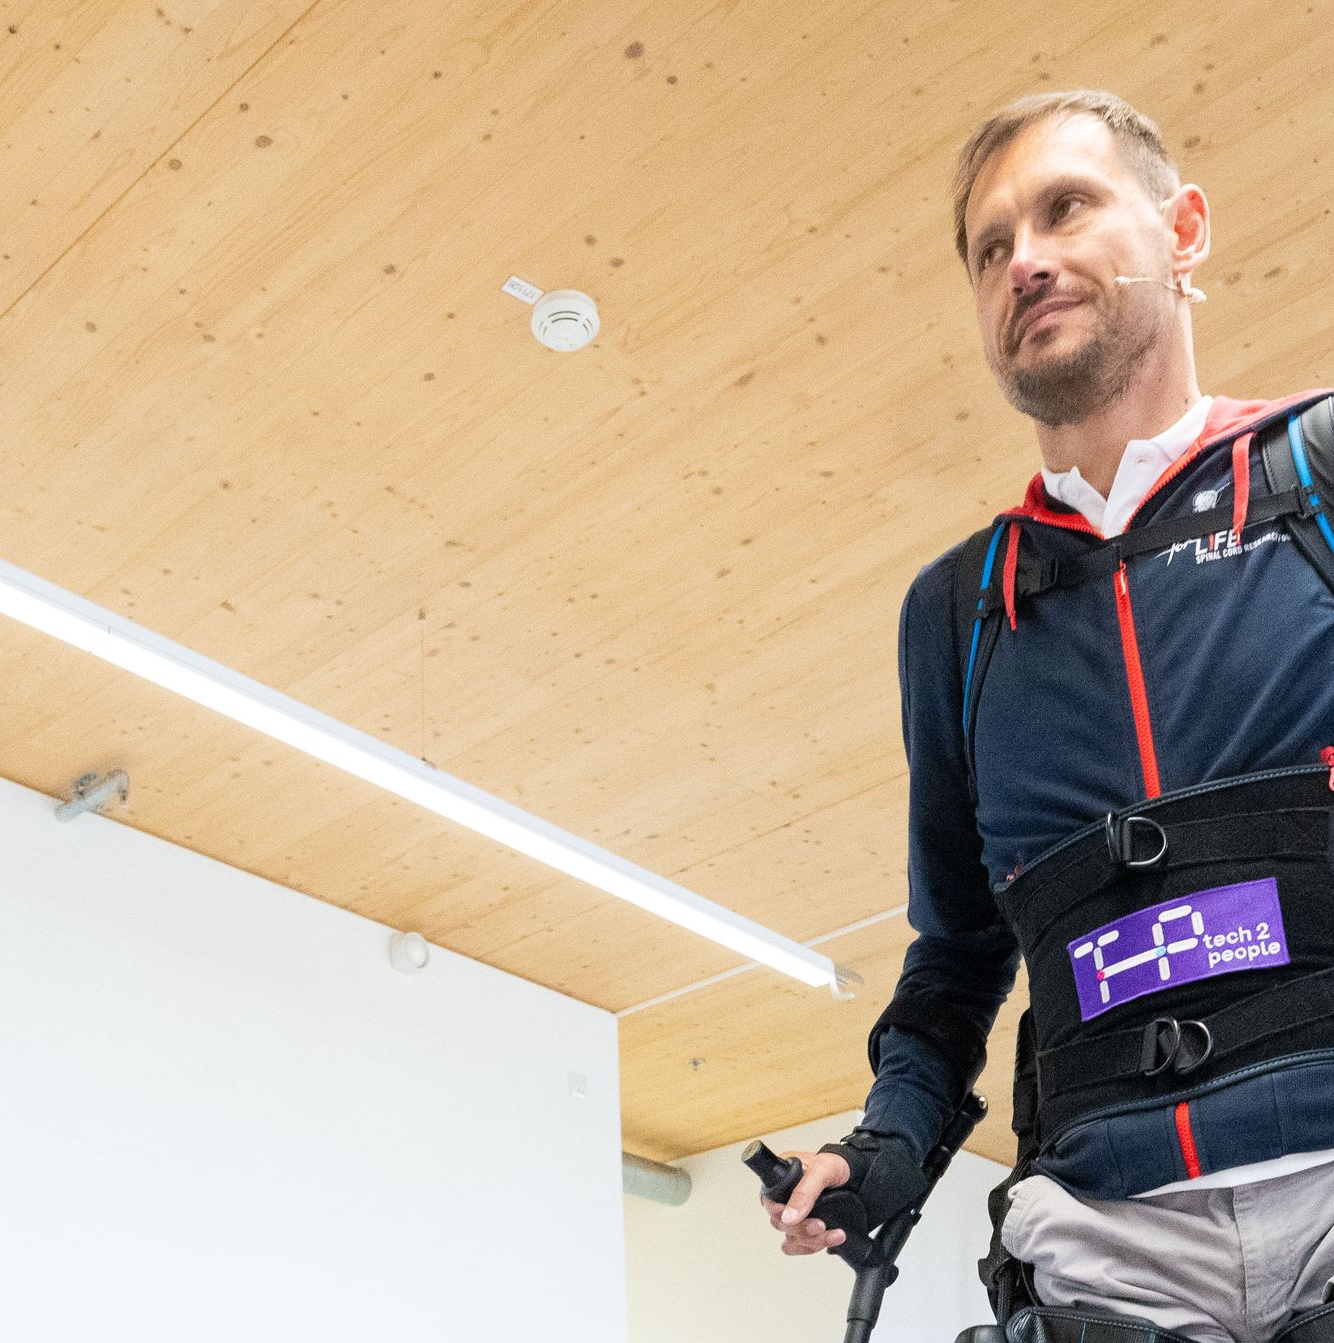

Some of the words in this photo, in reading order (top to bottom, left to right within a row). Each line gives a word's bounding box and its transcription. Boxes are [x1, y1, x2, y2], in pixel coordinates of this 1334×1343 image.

[1196, 550, 1222, 564] SPINAL
[1222, 545, 1243, 558] CORD
[1203, 926, 1252, 949] tech
[1256, 922, 1270, 941] 2
[1209, 940, 1281, 968] people
